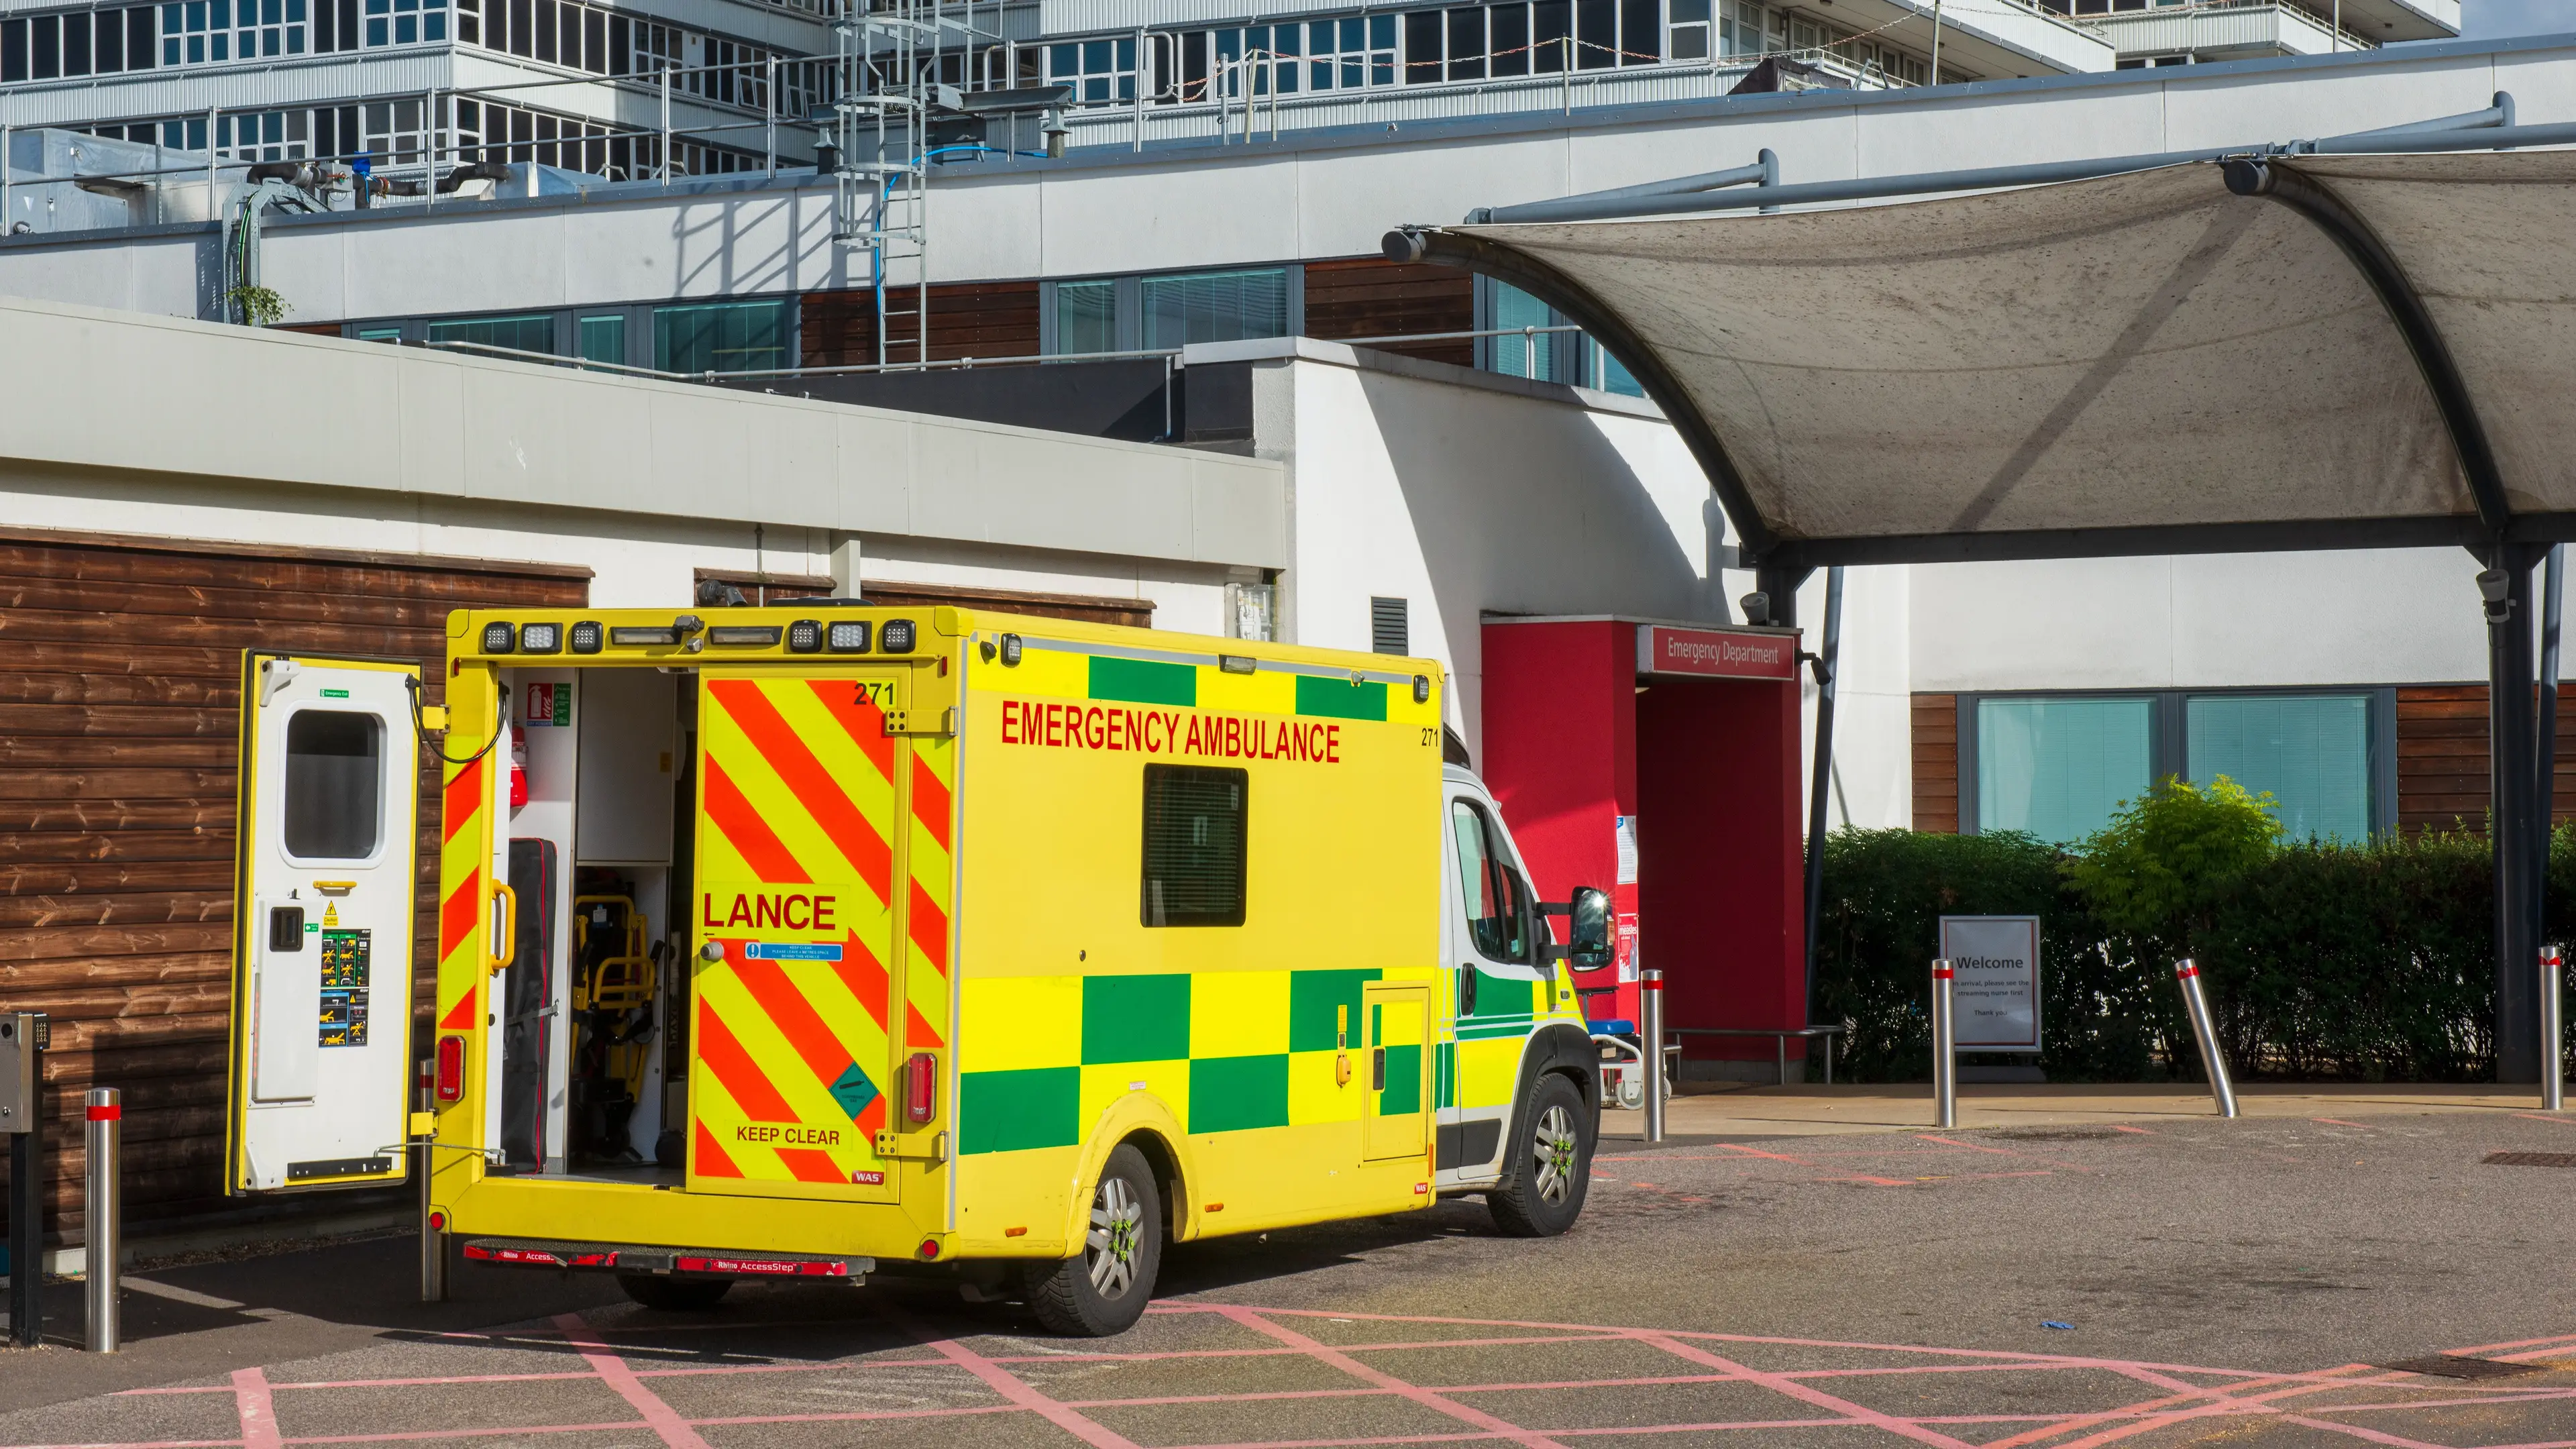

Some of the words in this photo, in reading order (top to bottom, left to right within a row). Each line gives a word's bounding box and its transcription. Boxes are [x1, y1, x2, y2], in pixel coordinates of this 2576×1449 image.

[1668, 637, 1721, 665] Emergency
[1723, 641, 1778, 666] Department
[853, 682, 894, 705] 271
[1002, 700, 1181, 753] EMERGENCY
[1184, 714, 1340, 763] AMBULANCE
[1421, 727, 1438, 747] 271
[704, 893, 836, 930] LANCE
[1619, 924, 1638, 935] measles
[1956, 956, 2024, 969] Welcome
[1984, 980, 2004, 989] please
[737, 1126, 780, 1142] KEEP
[785, 1128, 840, 1145] CLEAR
[503, 1251, 518, 1259] Rhino
